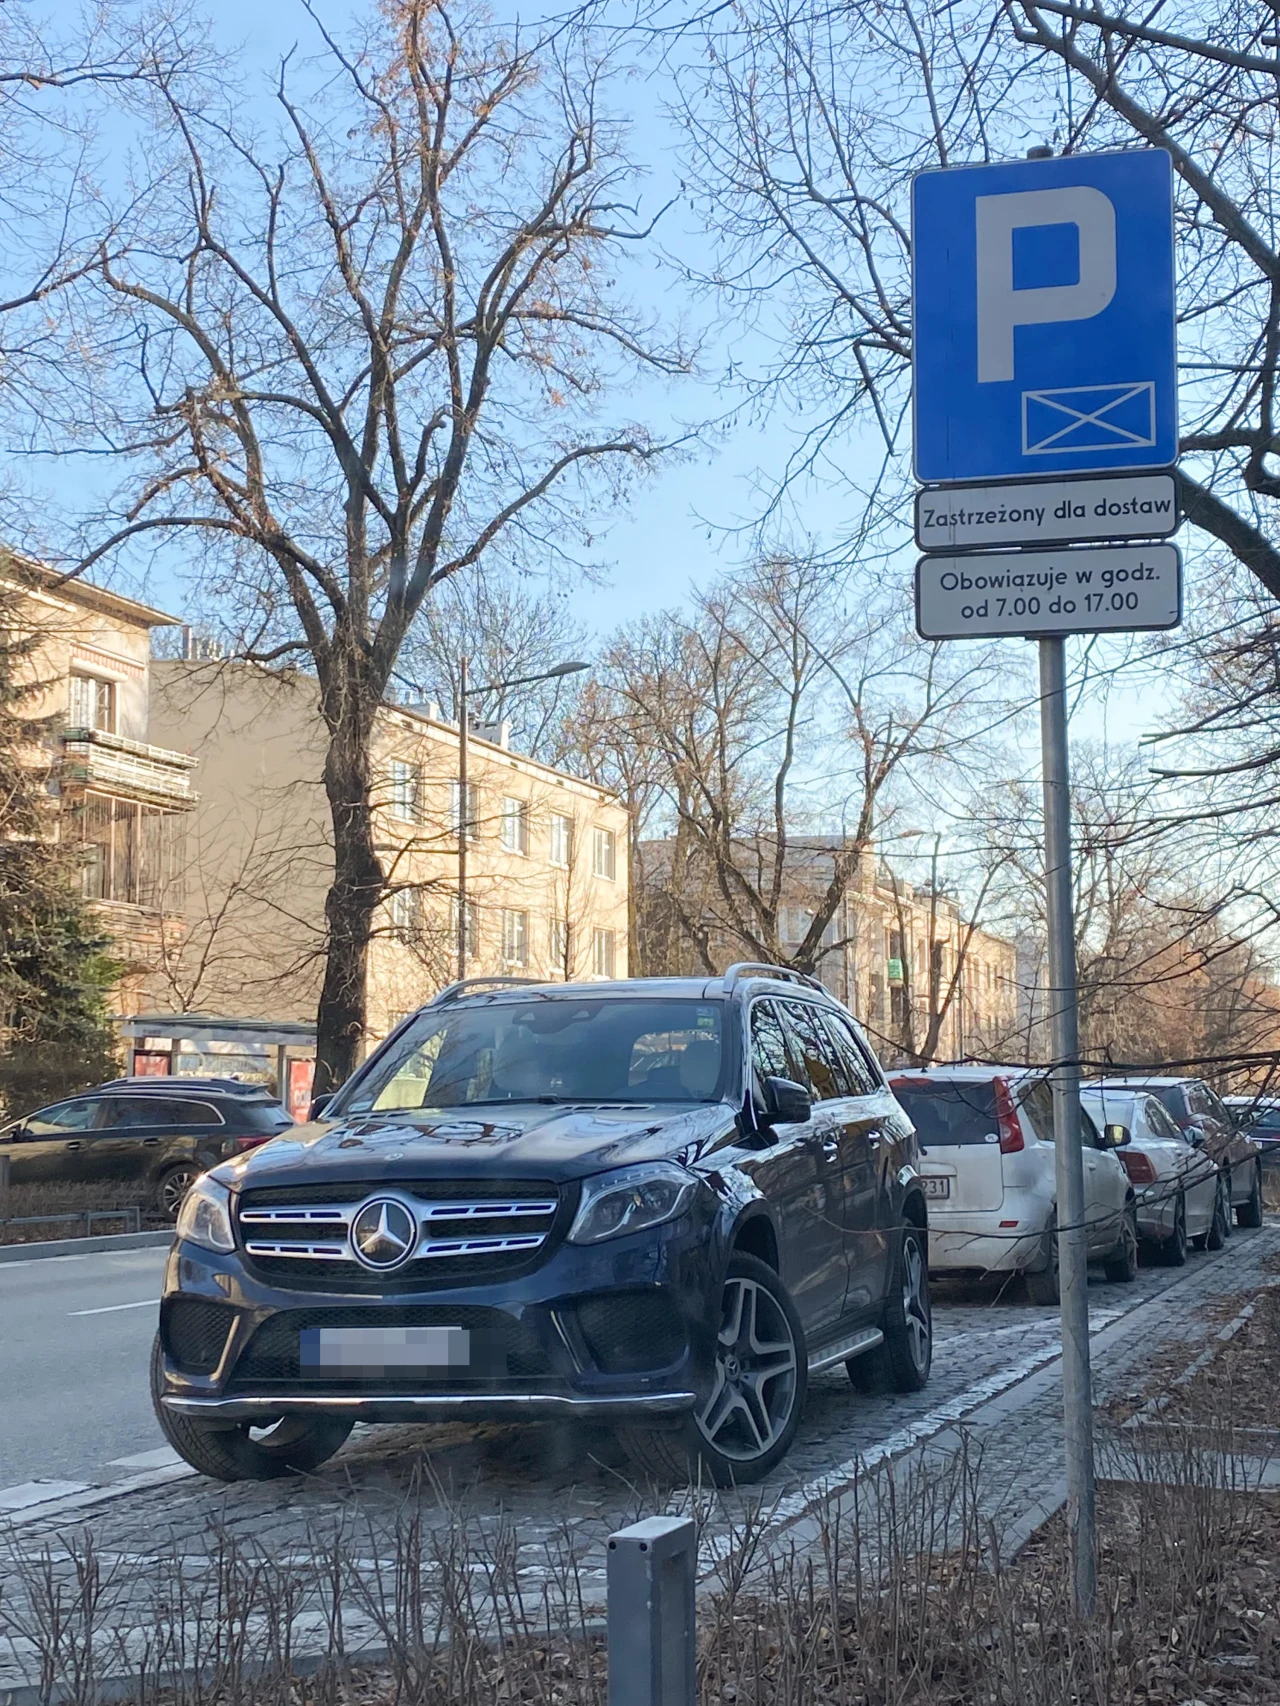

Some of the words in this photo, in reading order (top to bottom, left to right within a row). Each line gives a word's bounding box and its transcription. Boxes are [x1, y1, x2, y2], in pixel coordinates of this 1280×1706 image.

[976, 186, 1117, 383] P
[923, 504, 1045, 528] Zastrzeżony
[1054, 500, 1086, 519] dla
[1094, 497, 1171, 517] dostaw
[940, 566, 1067, 592] Obowiązuje
[1075, 570, 1093, 584] w
[1101, 562, 1161, 588] godz.
[961, 599, 989, 619] od
[996, 597, 1041, 617] 7.00
[1048, 595, 1077, 614] do
[1084, 591, 1139, 612] 17.00
